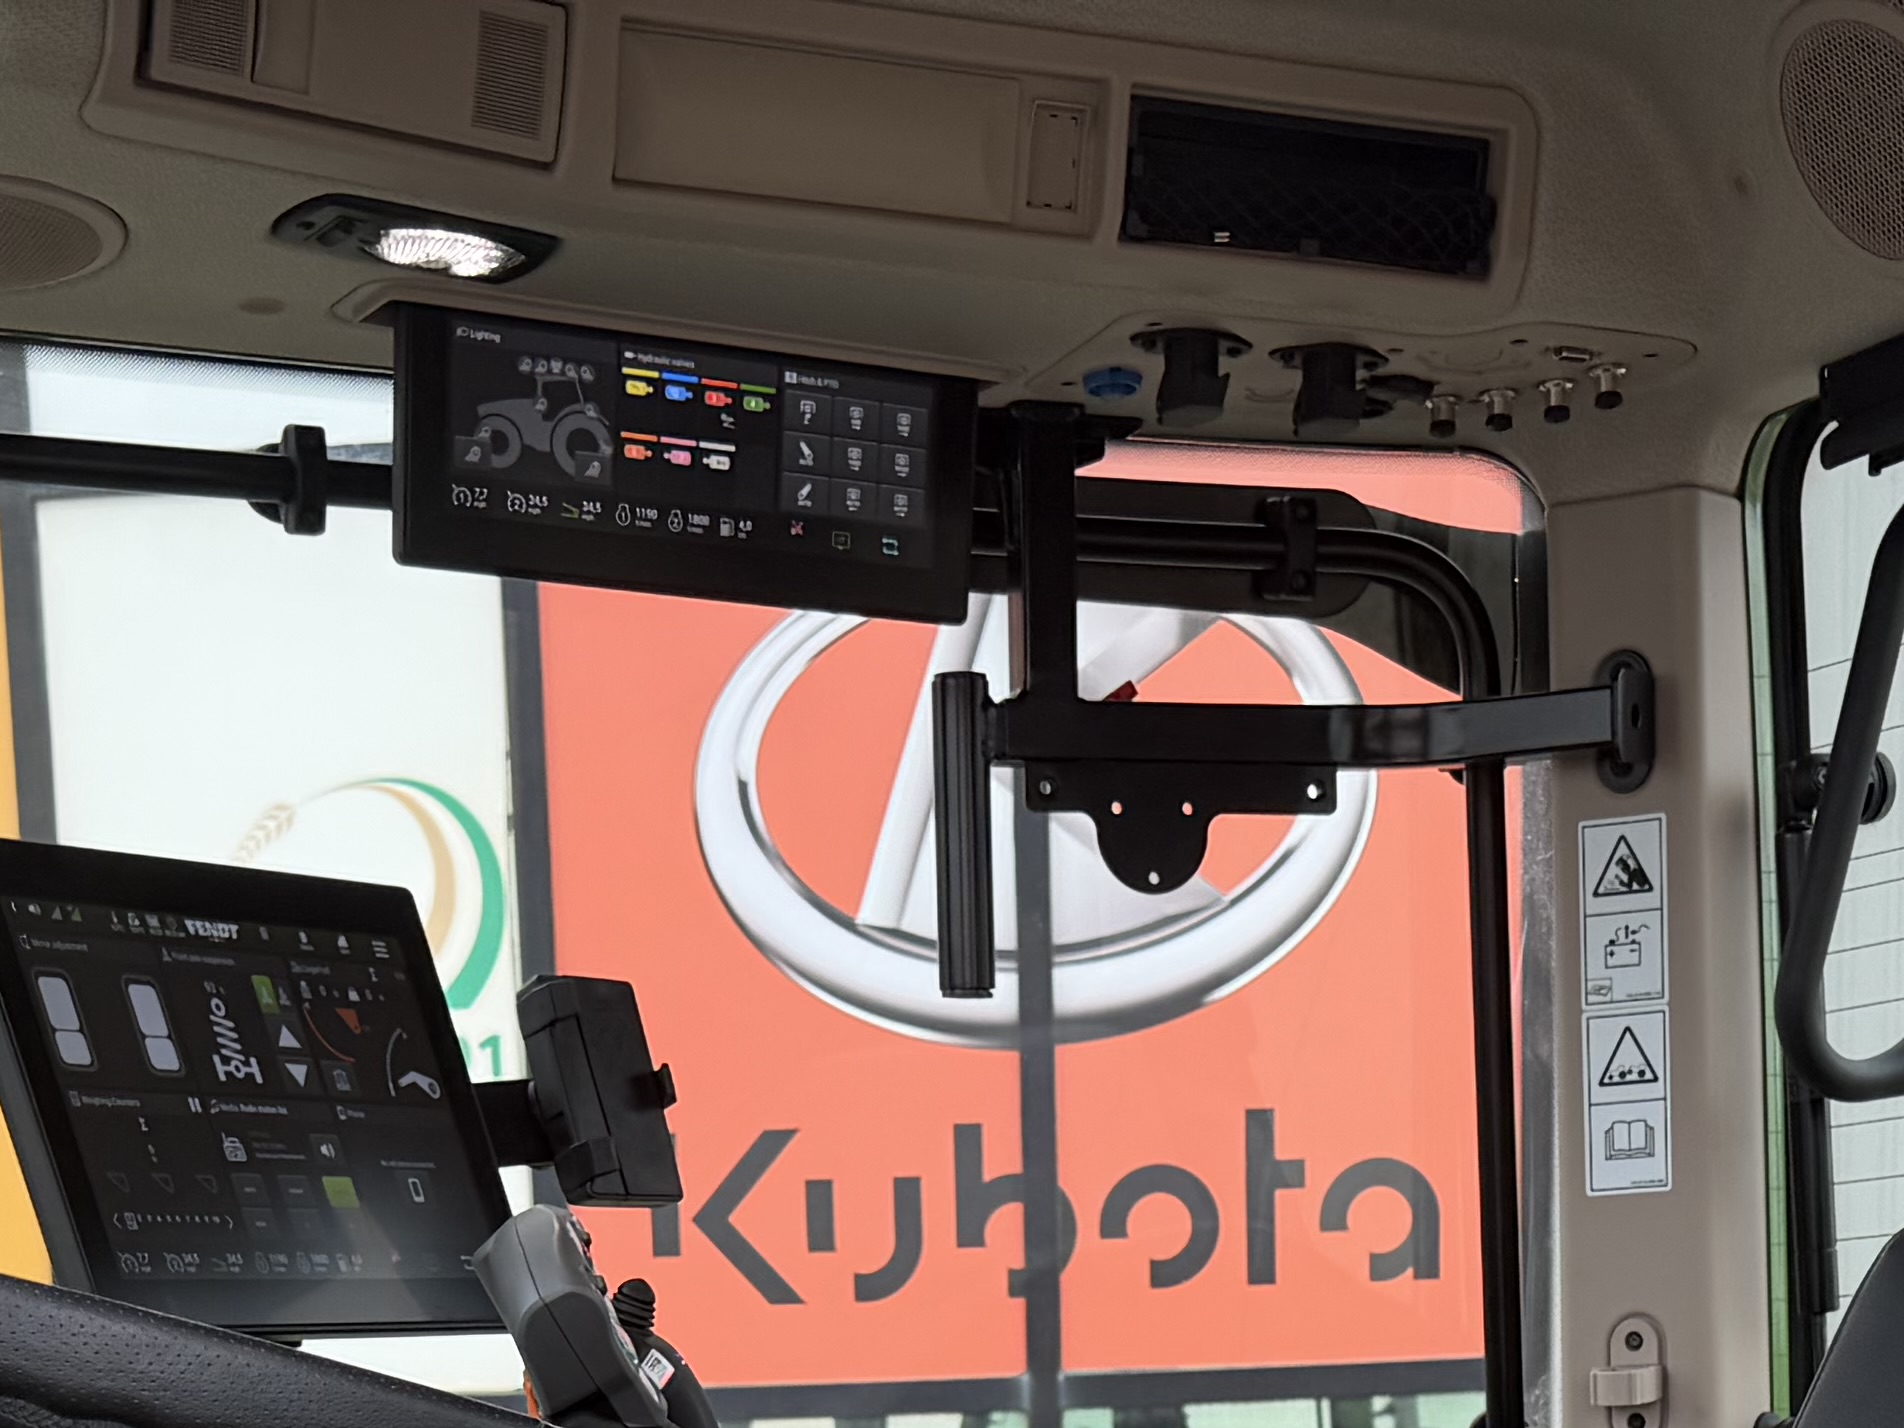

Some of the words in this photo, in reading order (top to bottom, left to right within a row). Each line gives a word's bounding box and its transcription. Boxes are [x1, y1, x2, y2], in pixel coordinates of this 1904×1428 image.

[469, 329, 502, 343] Lighting
[184, 919, 239, 940] FENDT
[651, 1108, 1441, 1305] Kubota
